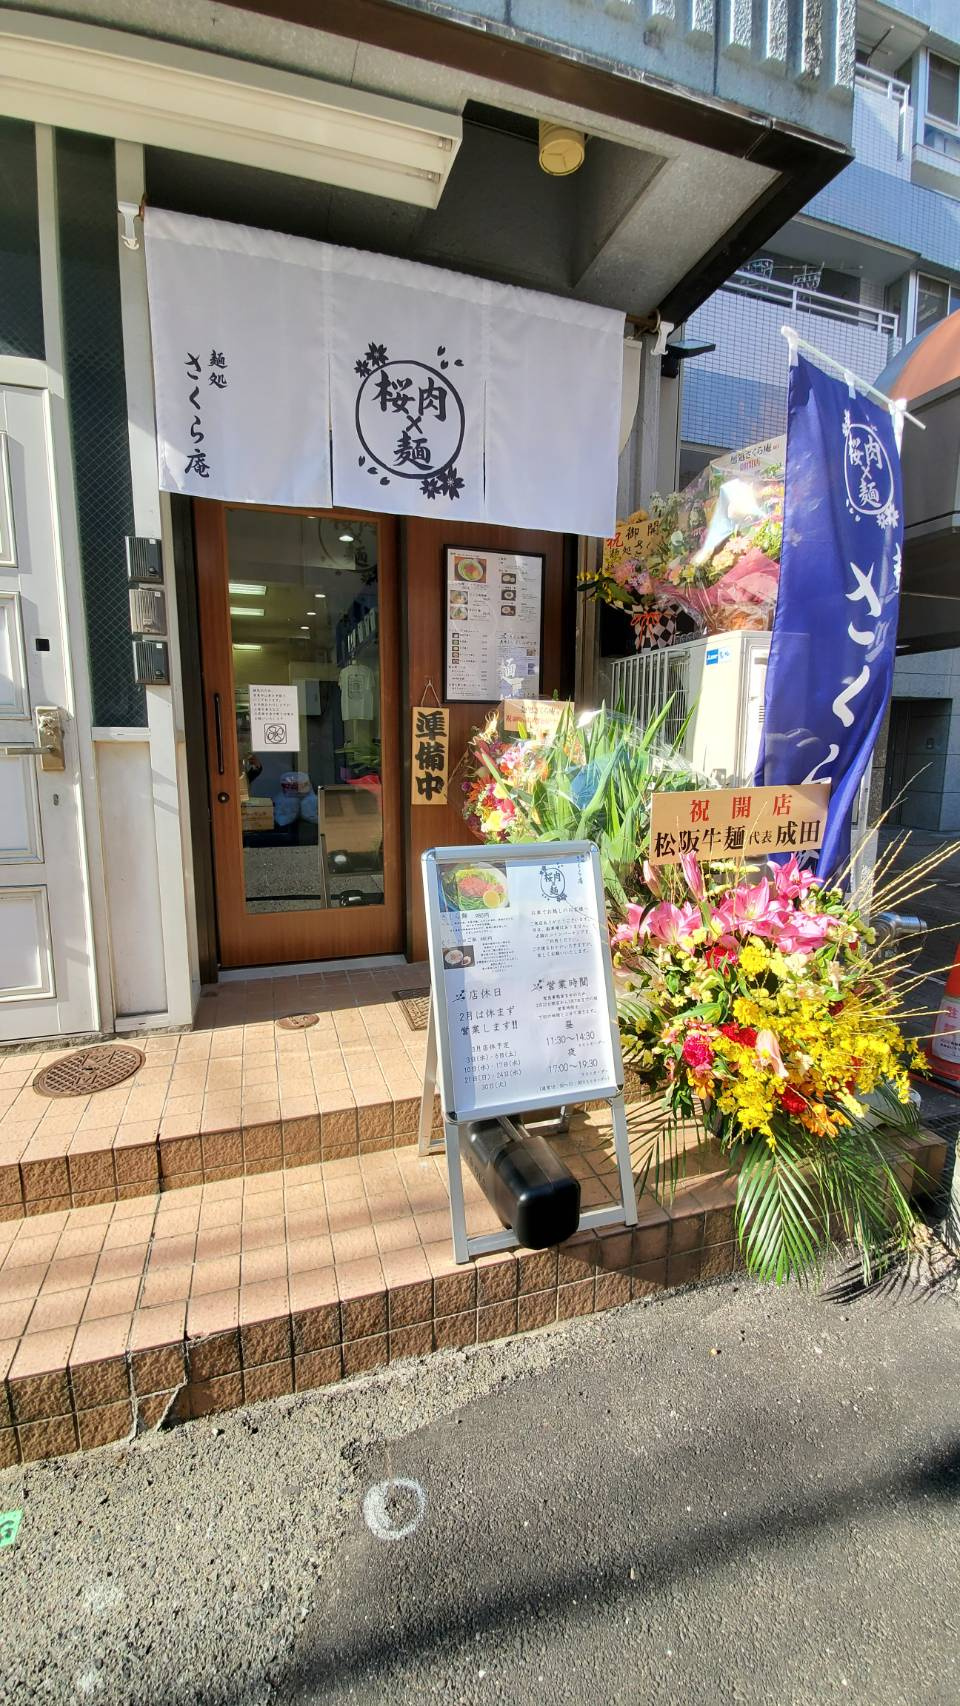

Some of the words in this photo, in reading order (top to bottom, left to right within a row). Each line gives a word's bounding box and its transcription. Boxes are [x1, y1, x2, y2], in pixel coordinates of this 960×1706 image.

[208, 349, 229, 389] 麺処
[184, 351, 210, 479] さくら庵
[372, 369, 448, 422] 桜肉
[392, 430, 433, 471] 麺
[848, 431, 883, 470] 桜肉
[858, 479, 882, 508] 麺
[414, 711, 448, 801] 準備中
[689, 793, 793, 823] 祝開店
[469, 987, 502, 1000] 店休日
[546, 976, 589, 991] 営業時間
[459, 1005, 515, 1021] 2月は休まず
